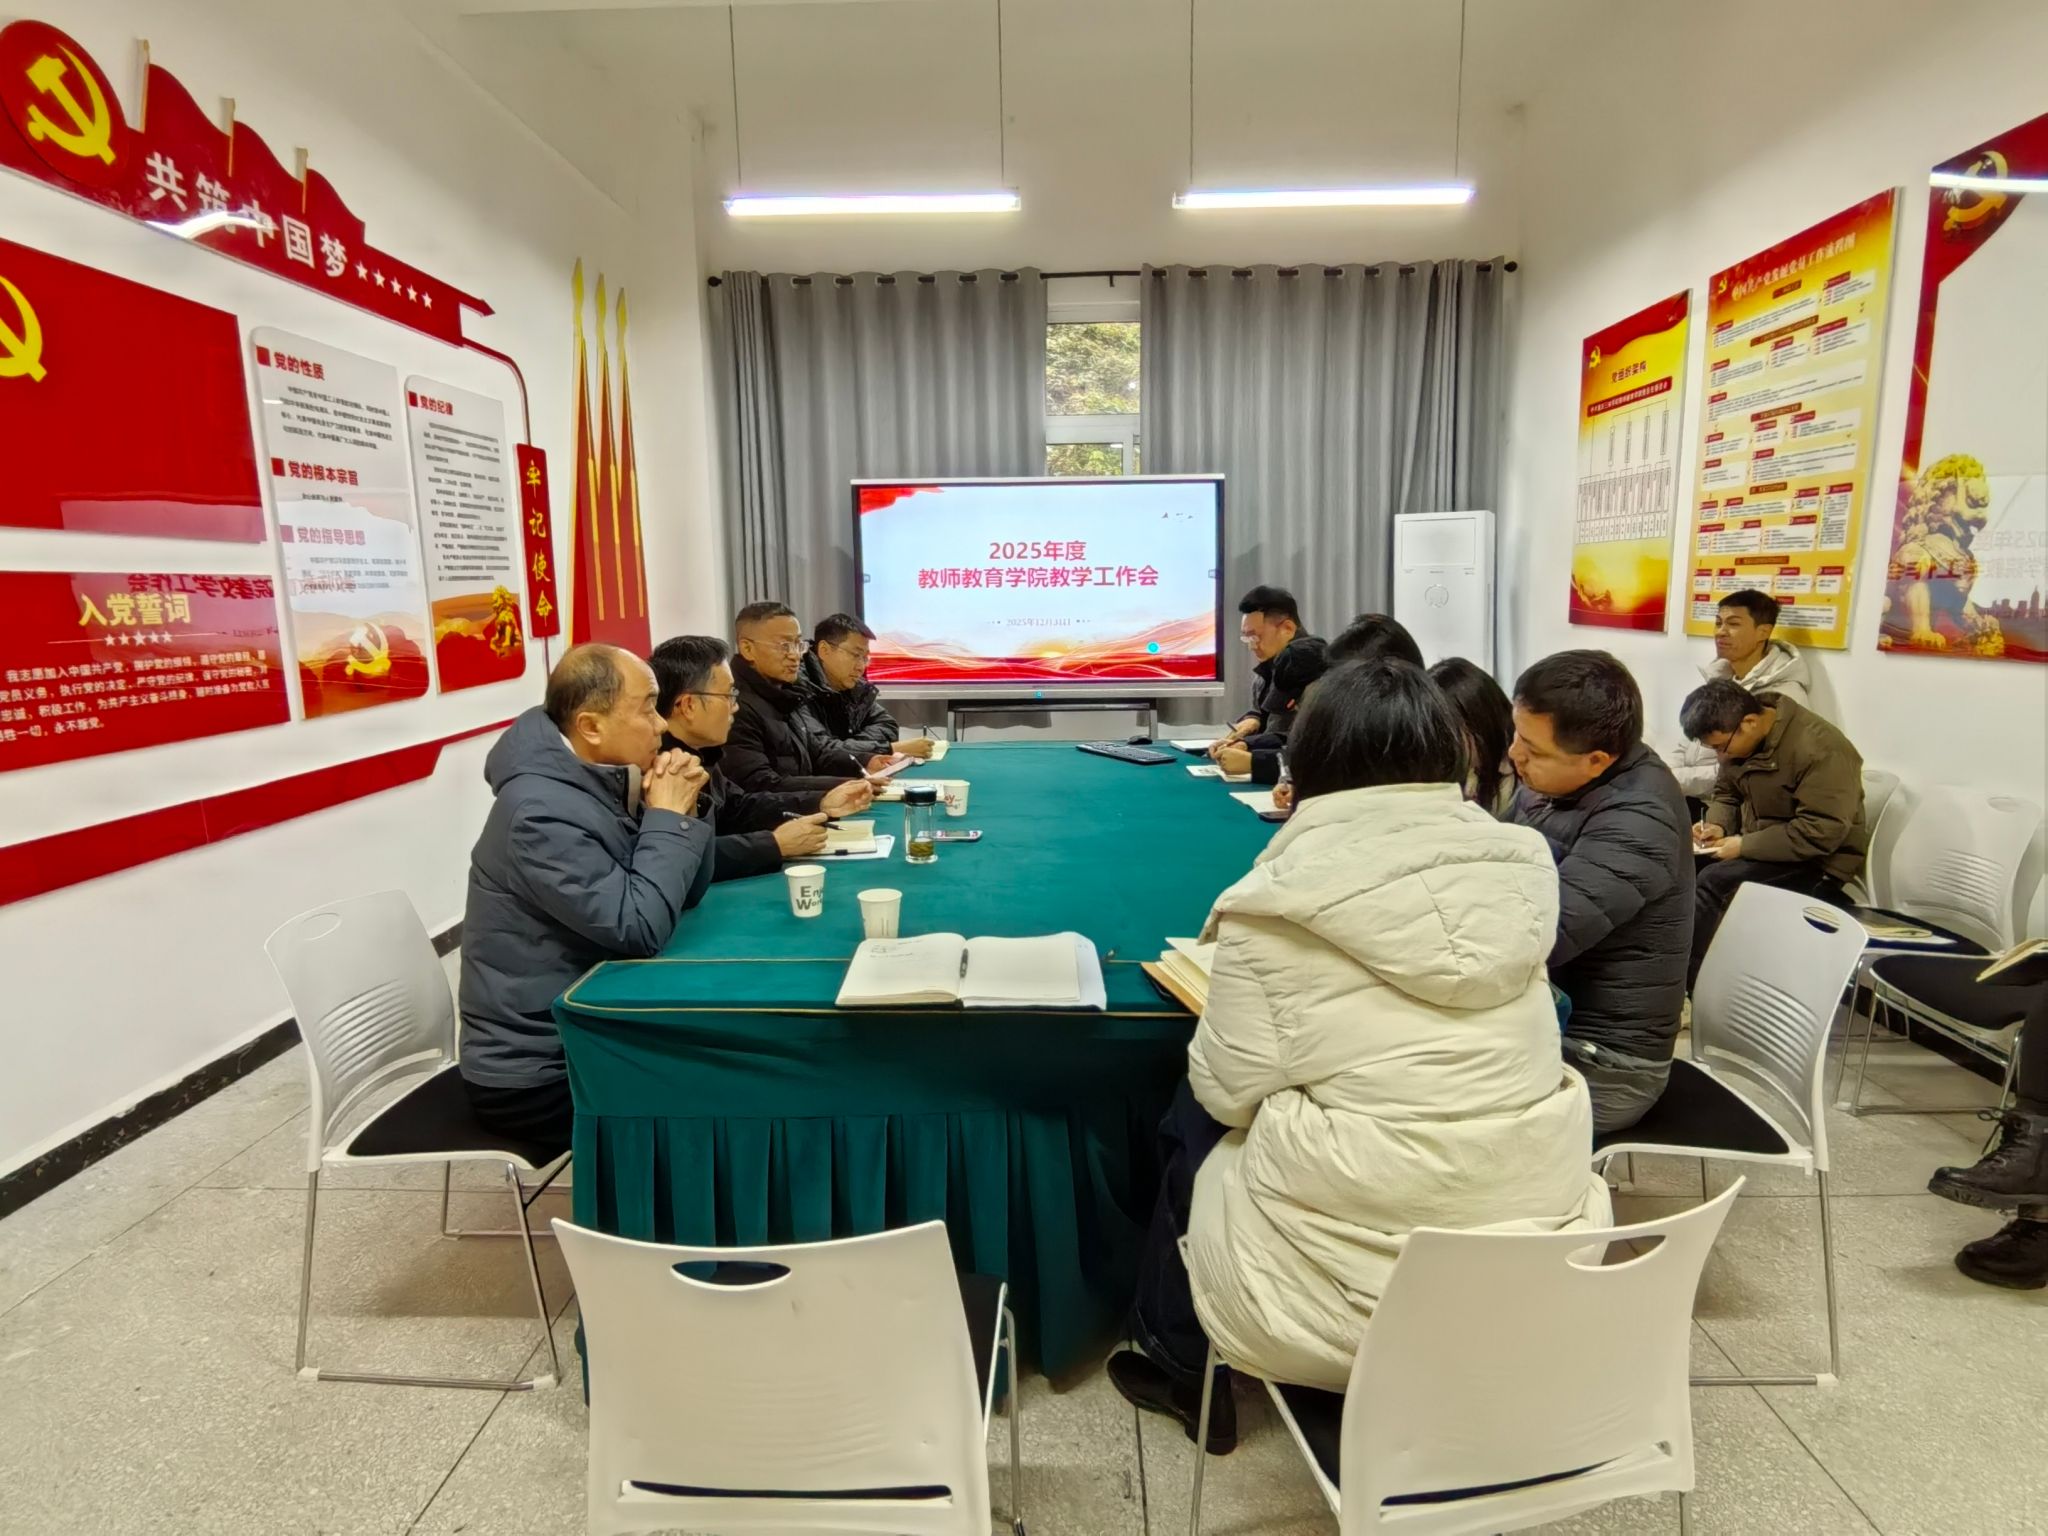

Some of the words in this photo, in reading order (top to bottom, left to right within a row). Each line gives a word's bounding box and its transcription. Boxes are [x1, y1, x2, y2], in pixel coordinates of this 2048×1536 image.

[146, 151, 348, 277] 共筑中国梦
[274, 352, 325, 380] 党的性质
[288, 461, 359, 486] 党的根本宗旨
[297, 527, 366, 546] 党的指导思想
[526, 459, 552, 627] 牢记使命
[989, 540, 1087, 561] 2025年度
[918, 565, 1159, 589] 教师教育学院教学工作会
[79, 592, 191, 627] 入党誓词
